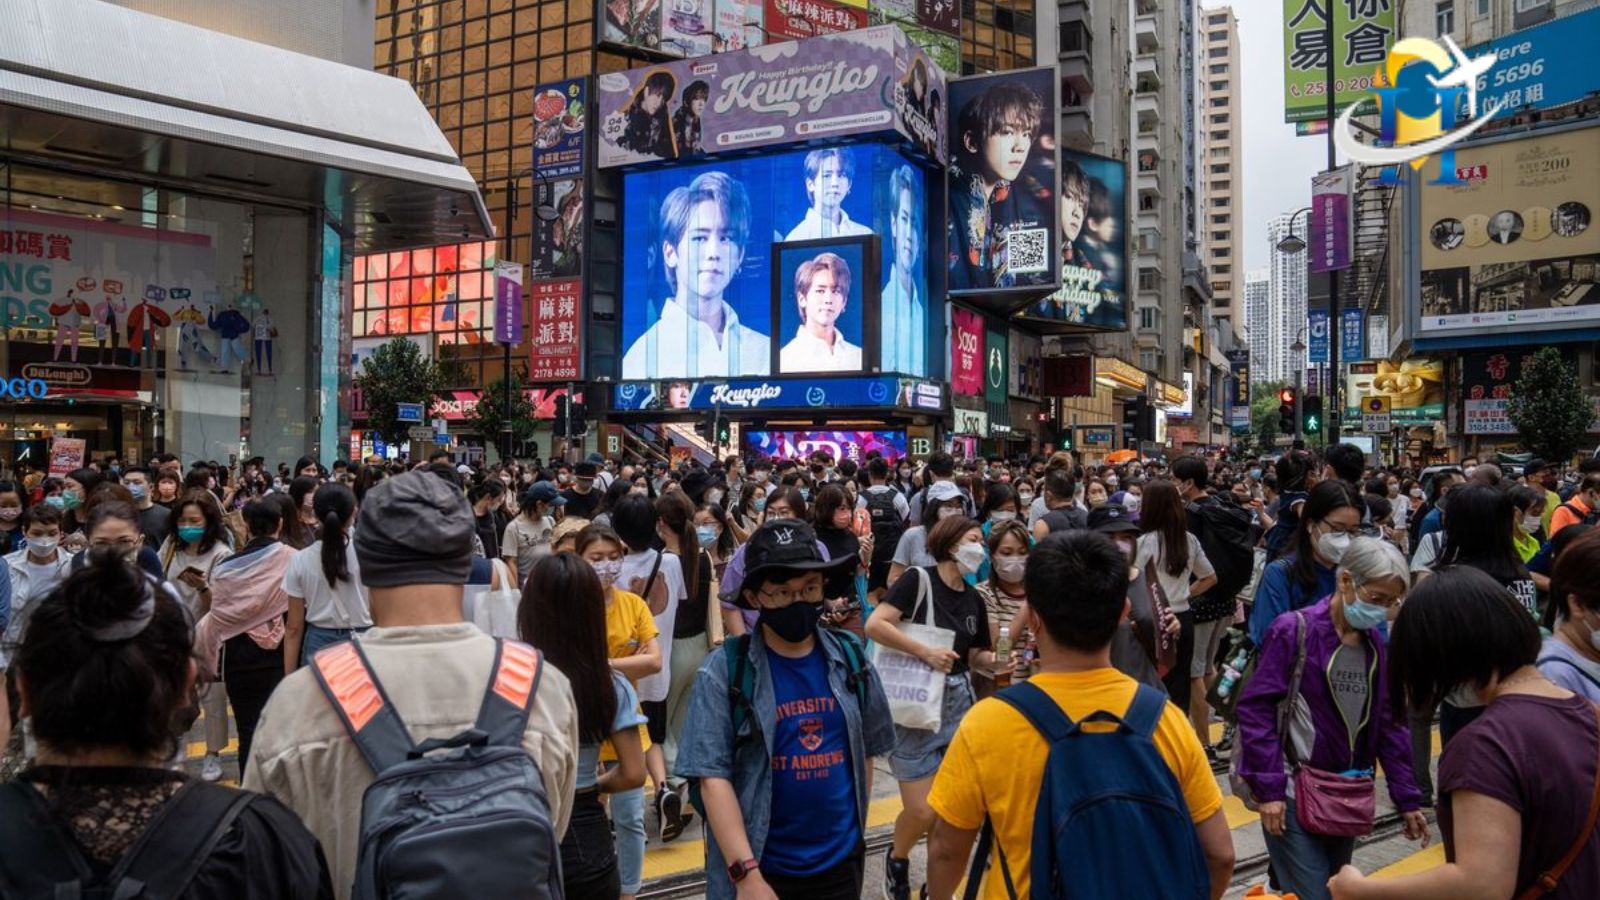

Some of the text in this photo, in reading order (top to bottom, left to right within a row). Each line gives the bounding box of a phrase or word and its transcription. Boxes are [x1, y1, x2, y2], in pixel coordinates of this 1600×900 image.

[1494, 58, 1545, 87] 5696
[1305, 80, 1344, 95] 250
[540, 295, 575, 320] 麻辣
[539, 321, 575, 344] 派對
[534, 369, 553, 378] 2178
[884, 684, 929, 702] EUNG
[791, 749, 844, 770] ANDREWS
